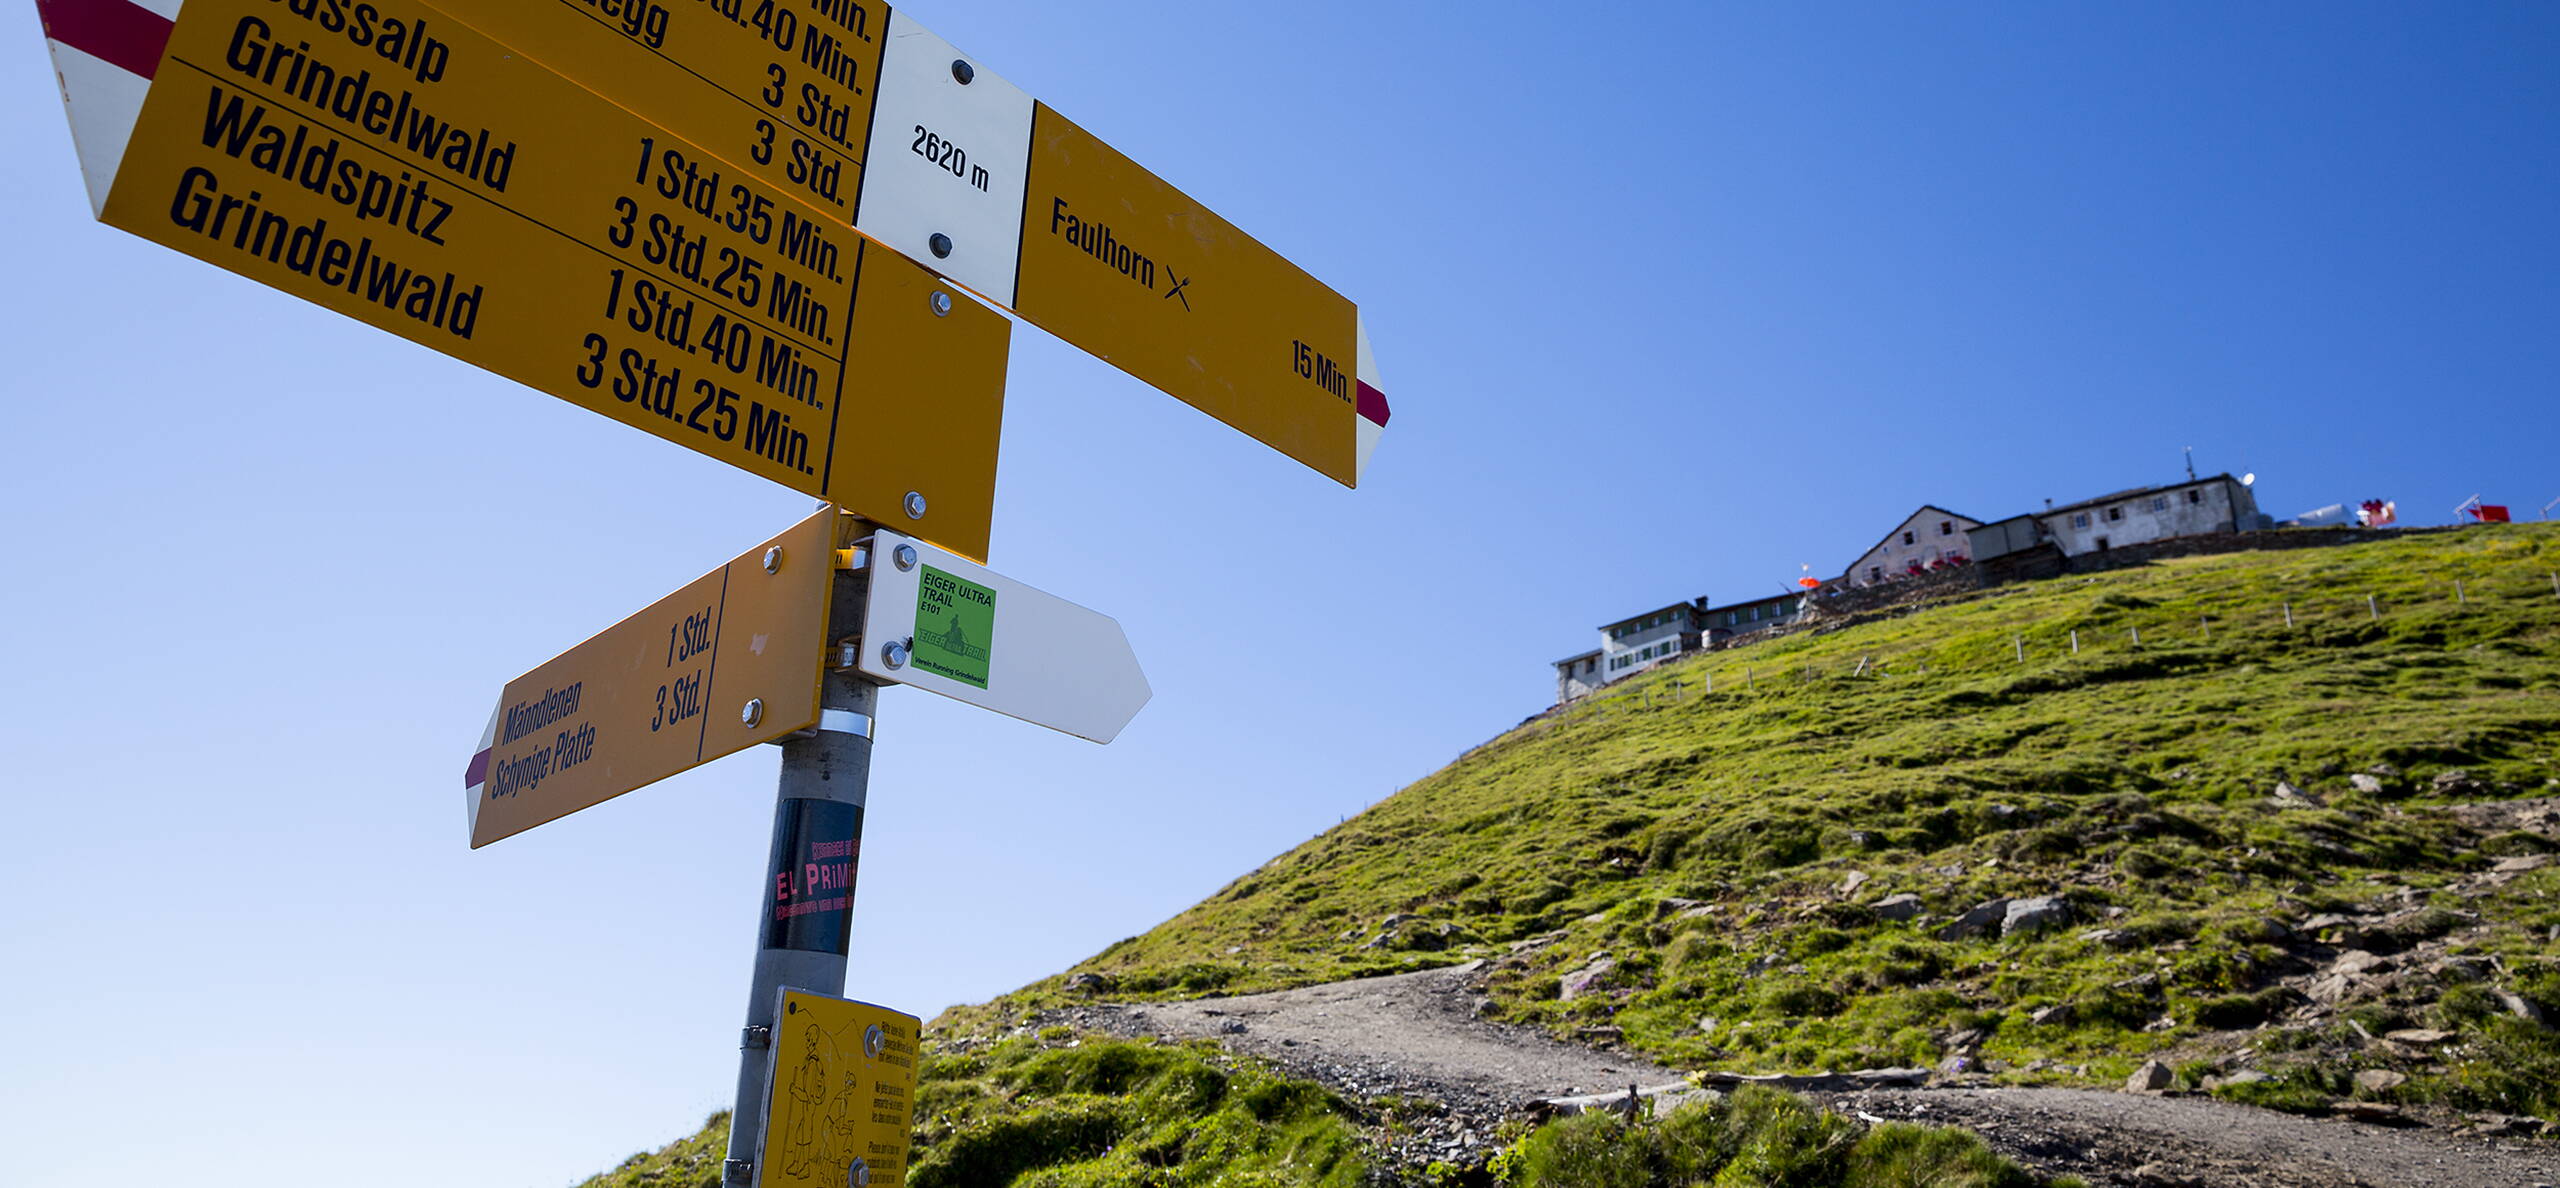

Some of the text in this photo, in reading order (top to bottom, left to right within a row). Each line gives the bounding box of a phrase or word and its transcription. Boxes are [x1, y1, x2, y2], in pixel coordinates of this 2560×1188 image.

[801, 23, 863, 97] Min.
[762, 62, 787, 109] 3
[796, 82, 854, 151] Std.
[225, 15, 517, 193] Grindelwald
[608, 196, 639, 249] 3
[767, 271, 834, 347] Min.
[750, 119, 845, 208] 3 Std.
[911, 124, 990, 193] 2620 m
[635, 137, 655, 186] 1
[777, 210, 844, 285] Min.
[1051, 196, 1156, 291] Faulhorn
[201, 85, 454, 248] Waldspitz
[605, 268, 626, 321] 1
[755, 335, 826, 411] Min.
[169, 166, 484, 341] Grindelwald
[576, 332, 609, 390] 3
[743, 400, 815, 476] Min.
[1292, 339, 1352, 404] 15 Min.
[920, 601, 941, 615] E101
[923, 587, 953, 608] TRAIL
[924, 572, 992, 607] EIGER ULTRA
[667, 605, 711, 668] 1 Std.
[502, 681, 582, 747] Männdlenen
[651, 669, 702, 732] 3 Std.
[491, 721, 596, 801] Schynige Platte
[776, 871, 799, 901] EL
